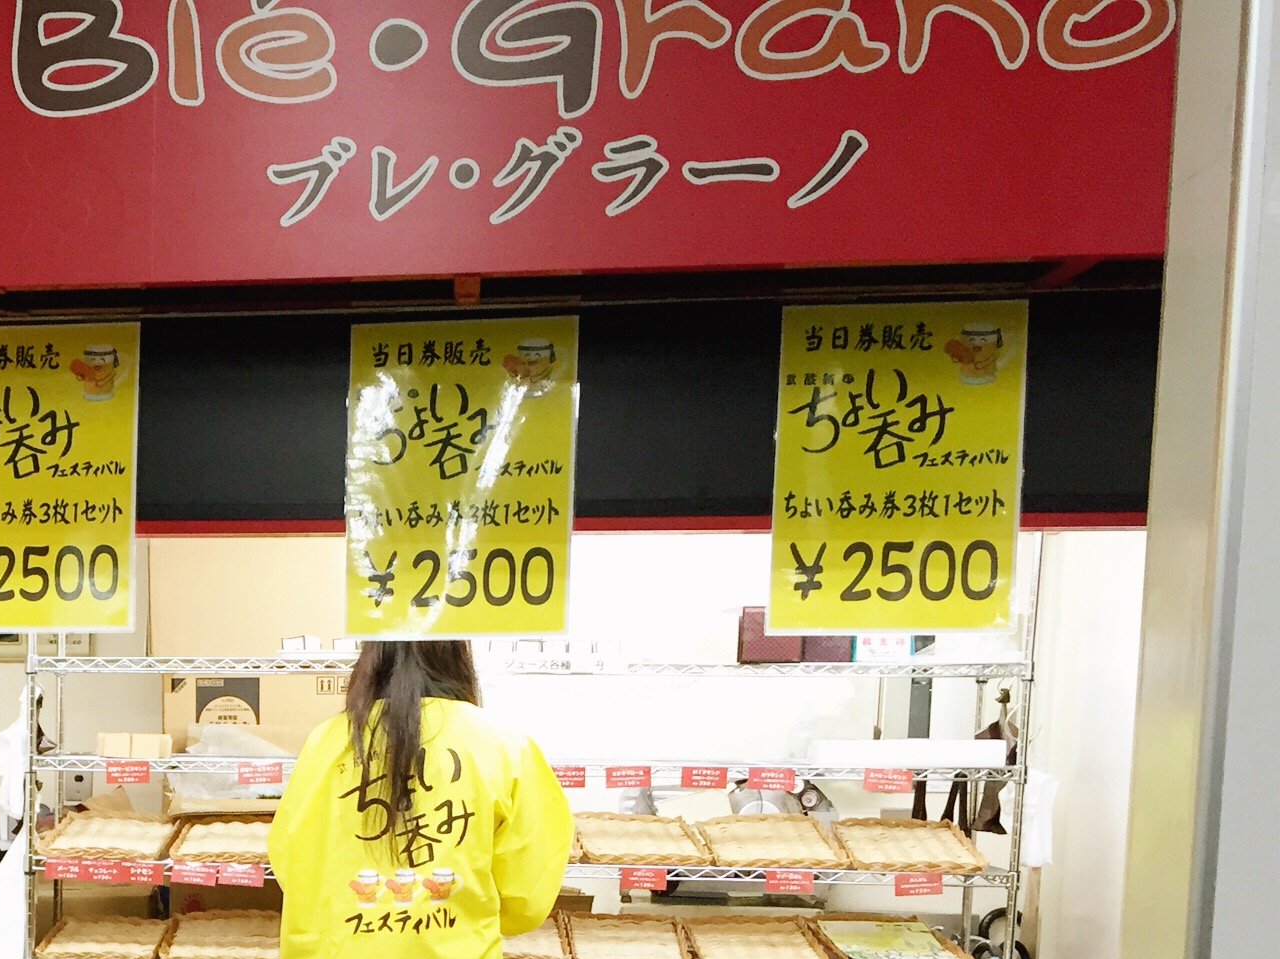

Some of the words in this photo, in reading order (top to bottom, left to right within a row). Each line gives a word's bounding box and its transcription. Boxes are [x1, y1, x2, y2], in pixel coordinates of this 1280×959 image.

[267, 126, 869, 228] ブレ・グラーノ
[803, 320, 934, 352] 当日券販売
[370, 338, 492, 368] 当日券販売
[786, 368, 955, 470] ちょい呑み
[45, 460, 127, 479] フェスティバル
[911, 447, 1010, 469] フェスティバル
[782, 488, 1005, 520] ちょい呑み券3枚1セット
[345, 907, 457, 935] フェスティバル
